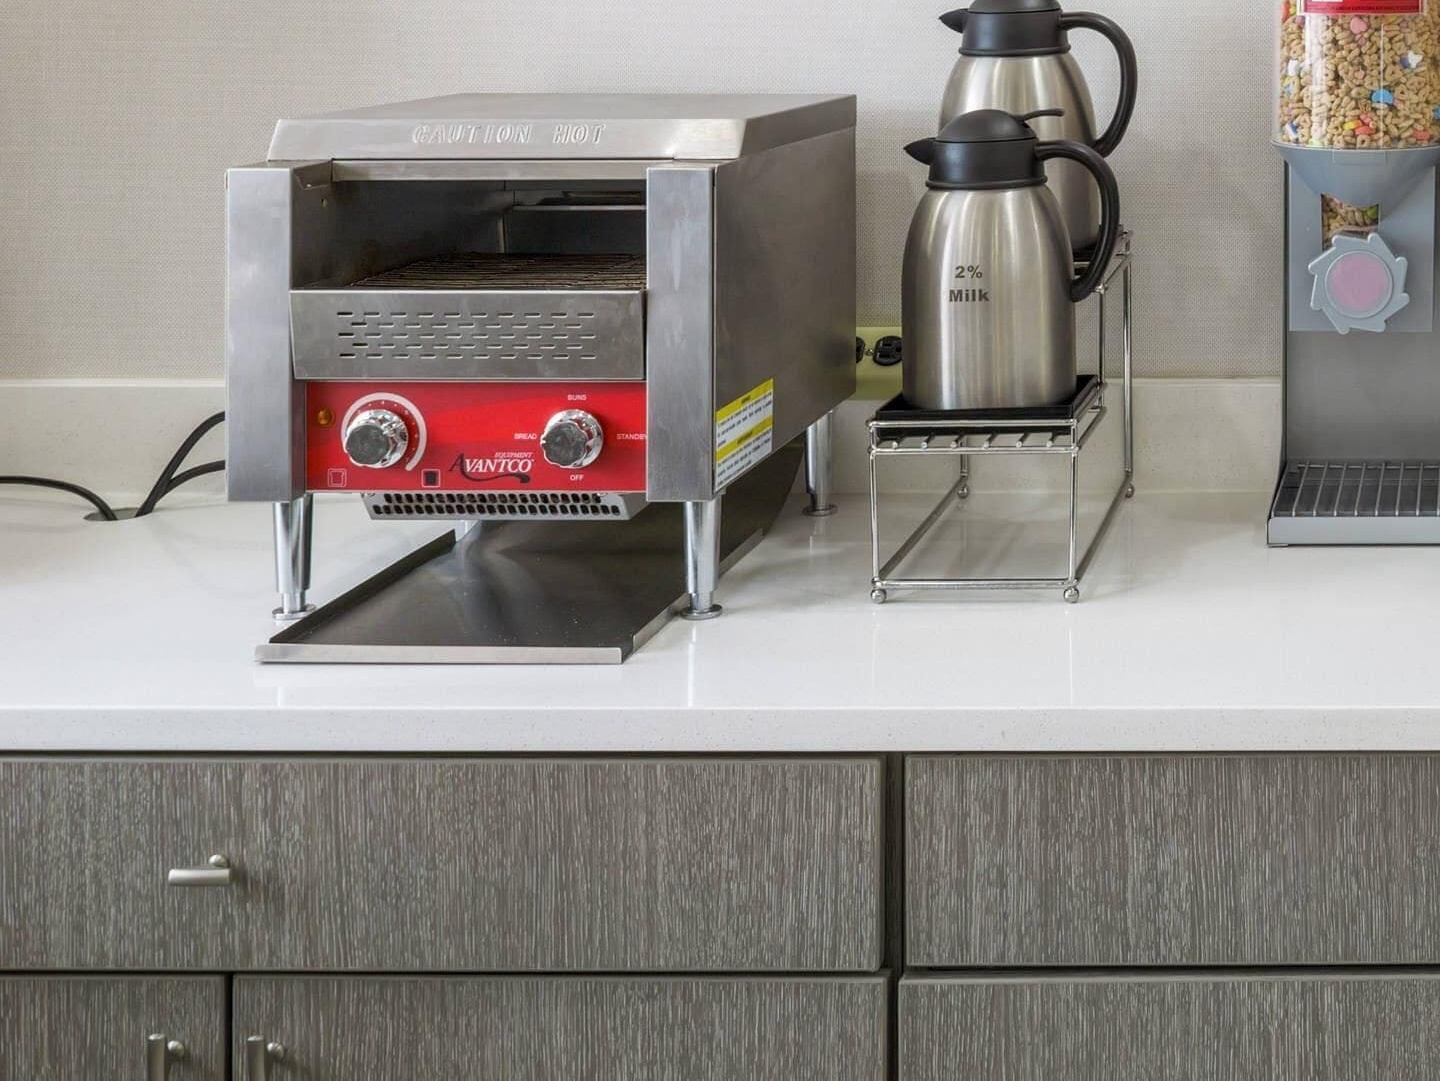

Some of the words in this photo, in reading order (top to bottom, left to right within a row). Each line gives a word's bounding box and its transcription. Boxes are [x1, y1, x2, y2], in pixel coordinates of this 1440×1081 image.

[412, 124, 532, 144] CAUTION
[552, 124, 606, 144] HOT
[955, 265, 983, 279] 2%
[949, 289, 990, 303] Milk
[448, 453, 533, 479] AVANTCO
